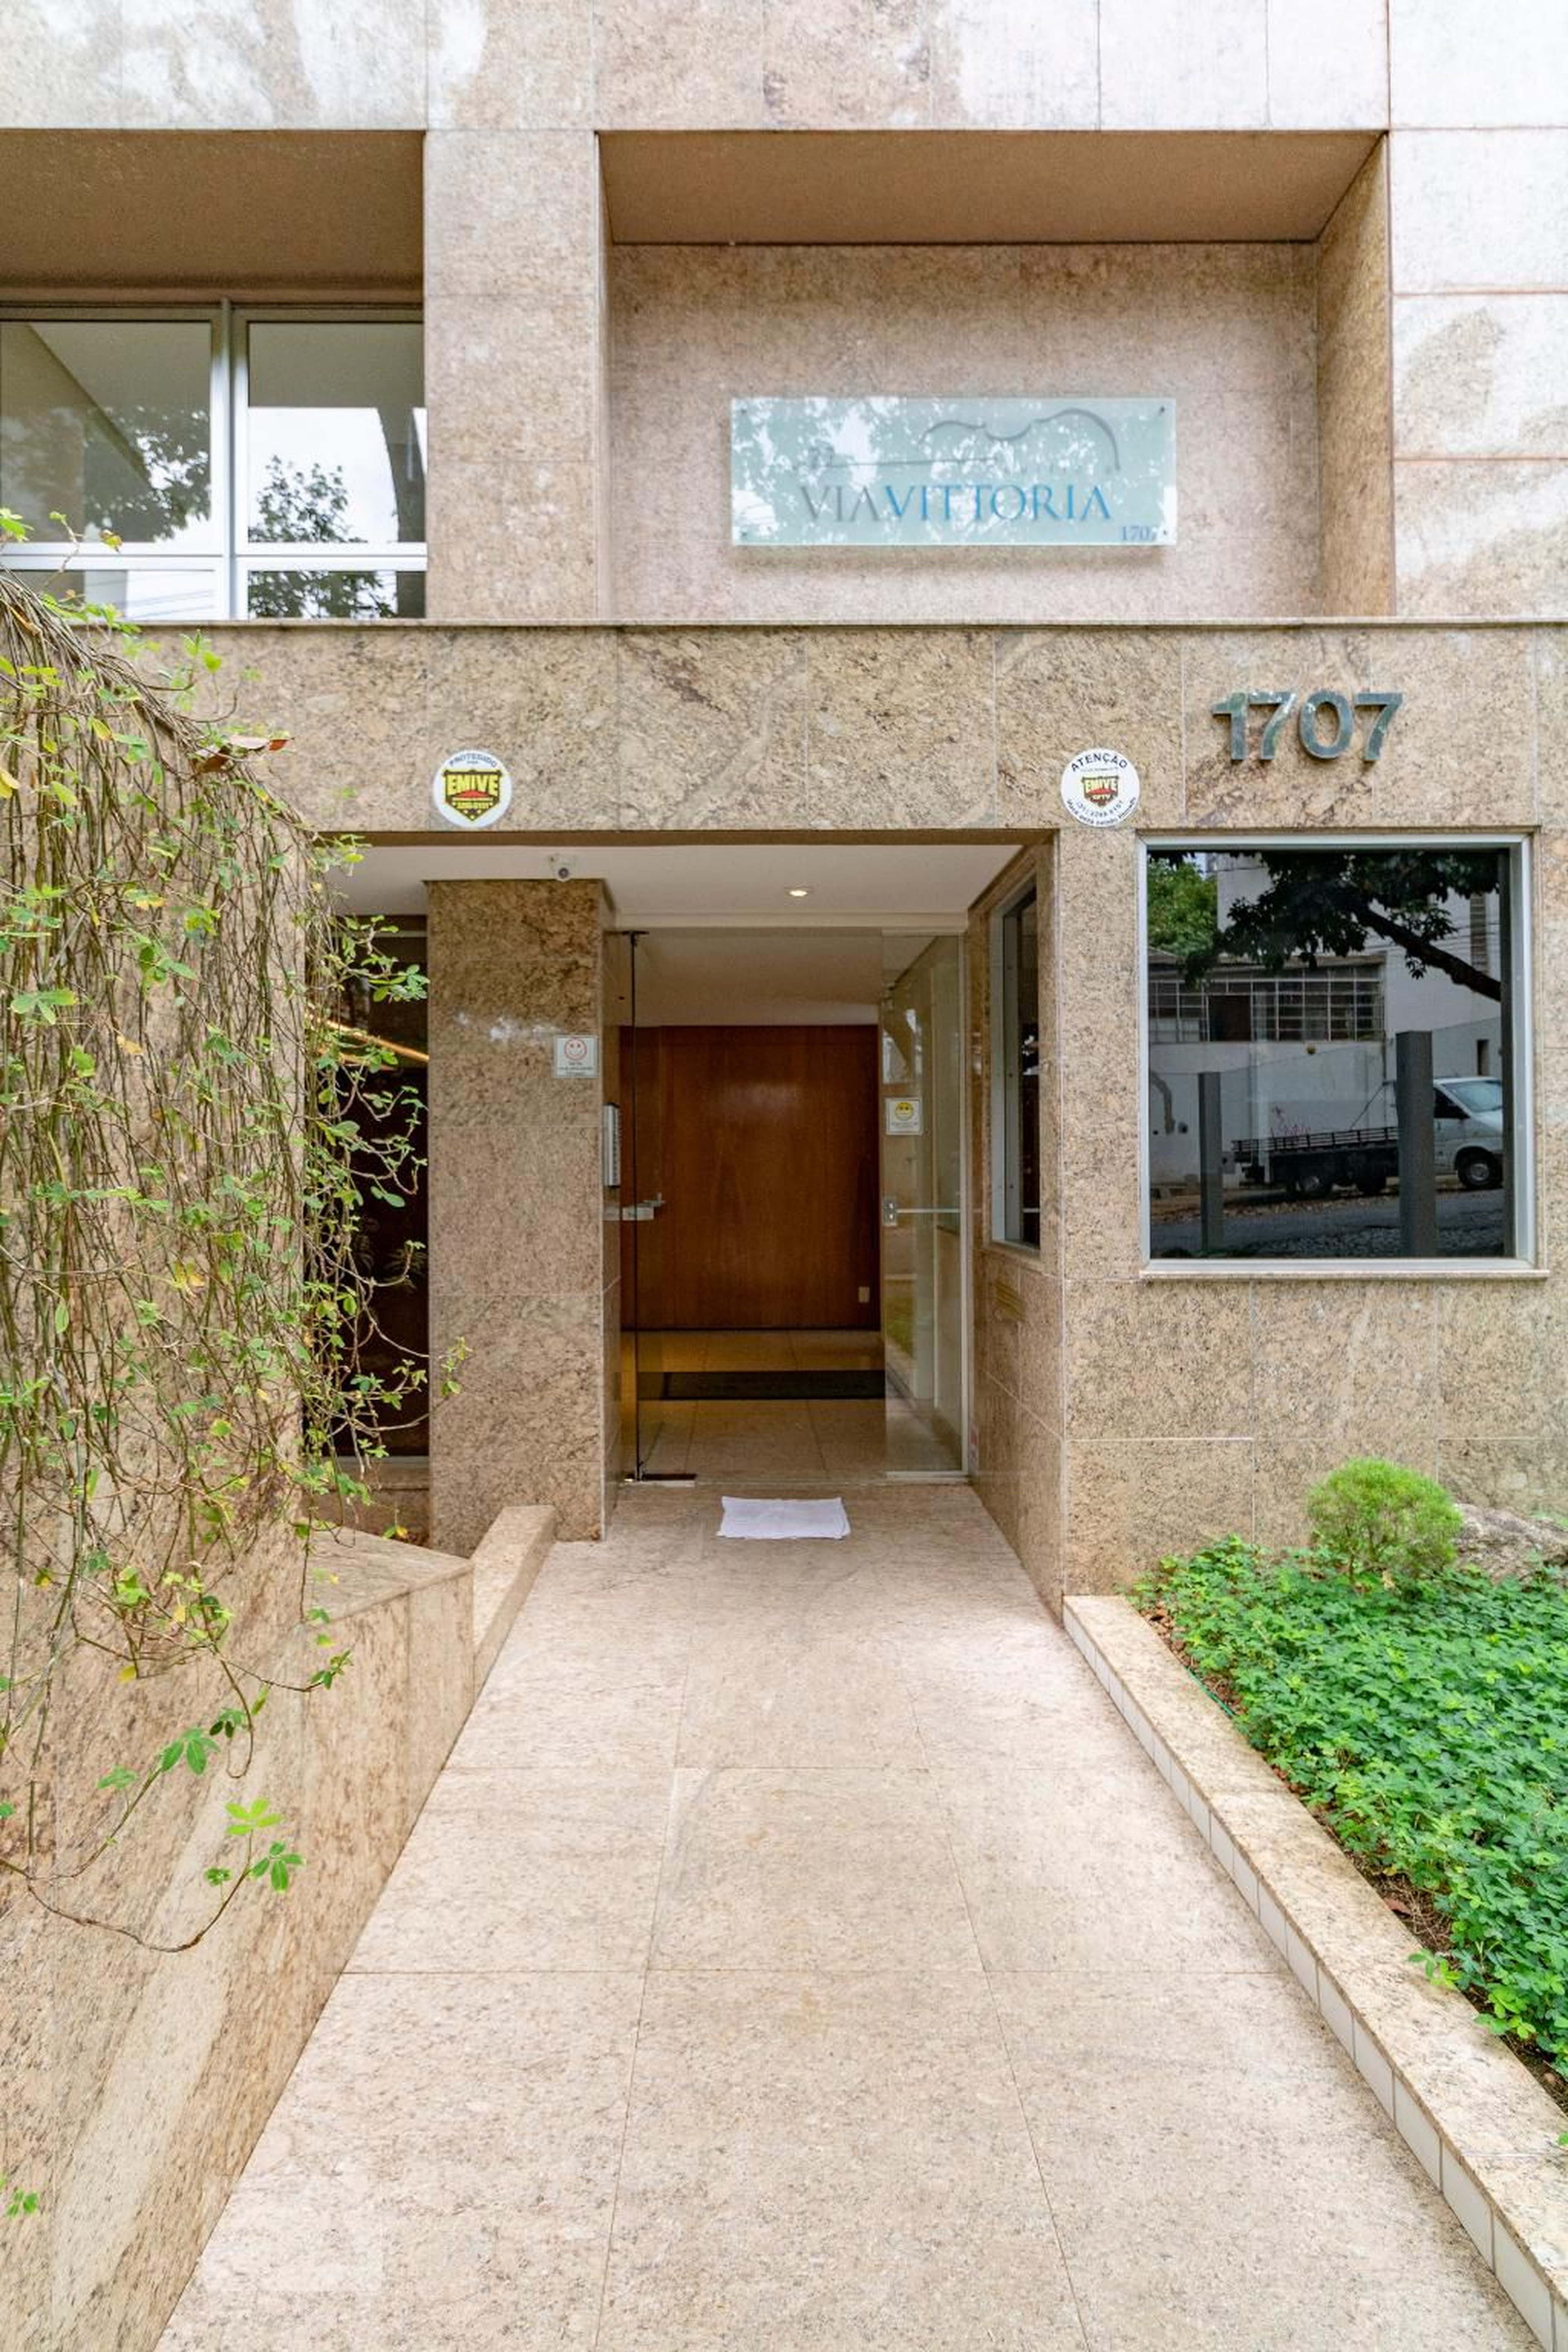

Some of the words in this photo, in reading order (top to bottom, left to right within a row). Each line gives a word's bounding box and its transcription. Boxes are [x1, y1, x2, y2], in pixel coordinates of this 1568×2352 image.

[1212, 690, 1404, 761] 1707
[1071, 753, 1128, 772] ATENÇÃO
[447, 773, 499, 796] EMIVE
